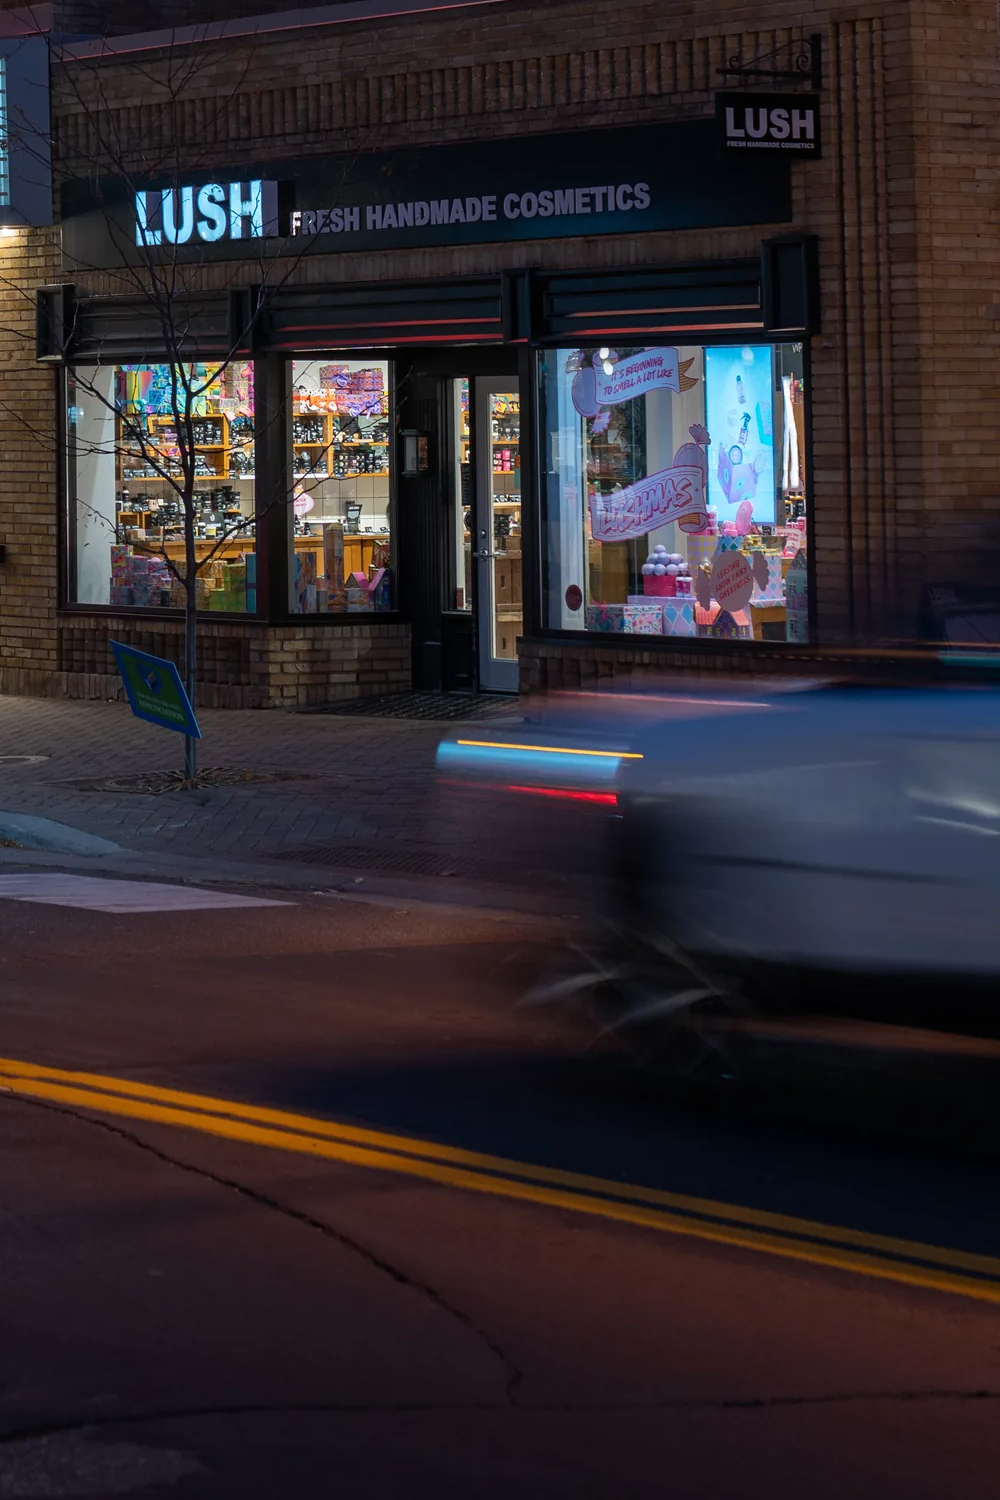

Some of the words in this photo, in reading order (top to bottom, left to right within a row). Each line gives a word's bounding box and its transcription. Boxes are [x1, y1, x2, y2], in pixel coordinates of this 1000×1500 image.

[726, 107, 815, 139] LUSH
[726, 140, 746, 148] FRESH
[747, 141, 780, 149] HANDMADE
[135, 180, 264, 247] LUSH
[290, 206, 360, 237] FRESH
[366, 195, 497, 230] HANDMADE
[503, 182, 651, 219] COSMETICS
[603, 386, 613, 396] TO
[613, 380, 636, 394] SMELL
[636, 377, 642, 385] A
[642, 370, 656, 383] LOT
[656, 368, 674, 379] LIKE
[625, 356, 665, 377] BEGINNING
[600, 478, 693, 535] LUSHMAS
